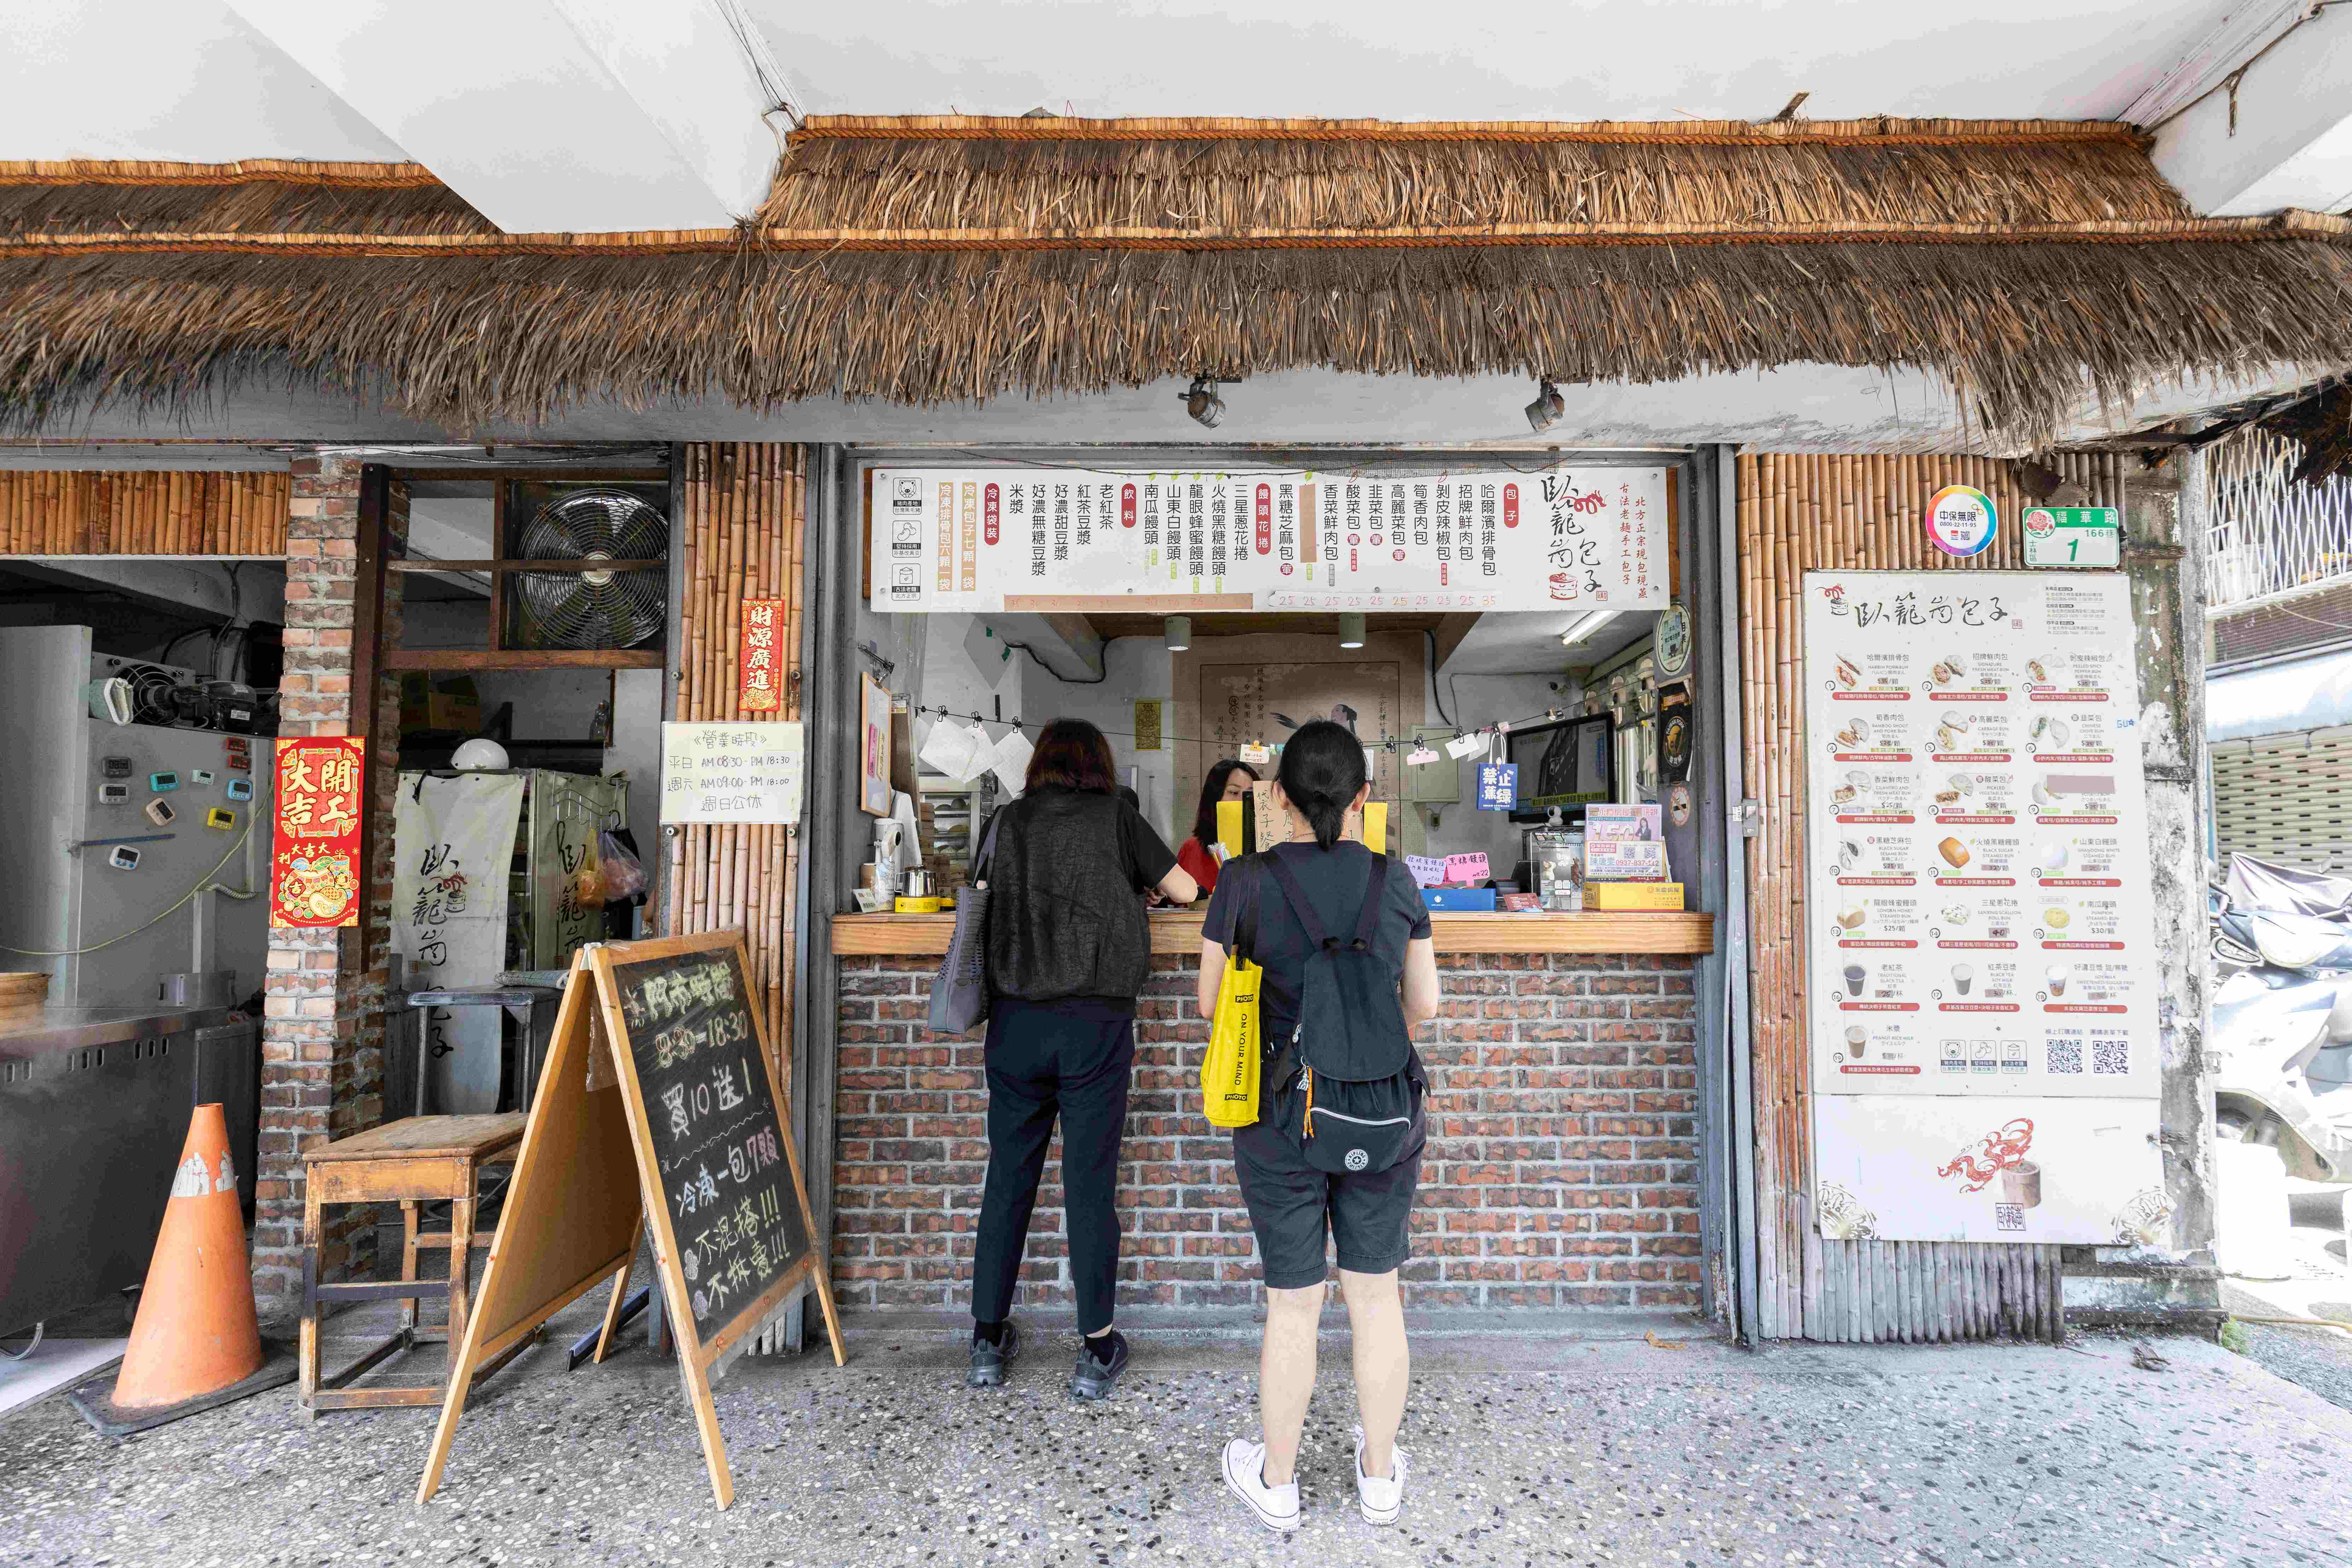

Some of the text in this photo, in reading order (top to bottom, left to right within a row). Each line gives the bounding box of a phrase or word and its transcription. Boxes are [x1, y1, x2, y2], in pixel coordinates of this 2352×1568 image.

[987, 488, 998, 538] 冷凍袋裝
[1010, 484, 1023, 513] 米漿
[1077, 484, 1090, 544] 紅茶豆漿
[1100, 484, 1113, 529] 老紅茶
[1124, 488, 1134, 521] 飲料
[1145, 484, 1158, 544] 南瓜饅頭
[1258, 488, 1269, 549] 饅頭花捲
[1347, 485, 1360, 529] 酸菜包
[1369, 485, 1382, 529] 韭菜包
[1392, 484, 1405, 544] 高麗菜包
[1414, 485, 1428, 544] 筍香肉包
[1505, 488, 1517, 521] 包子
[1939, 511, 1977, 521] 中保無限
[2056, 510, 2117, 524] 福華路
[939, 484, 951, 590] 冷凍排骨包六顆一袋
[963, 484, 975, 589] 冷凍包子七顆一袋
[1032, 484, 1046, 575] 好濃無糖豆漿
[1054, 484, 1068, 560] 好濃甜豆漿
[1167, 485, 1181, 560] 山東白饅頭
[1190, 484, 1203, 575] 龍眼蜂蜜饅頭
[1212, 484, 1225, 575] 火燒黑糖饅頭
[1280, 485, 1293, 560] 黑糖芝麻包
[1324, 485, 1338, 560] 香菜鮮肉包
[1437, 485, 1450, 560] 剝皮辣椒包
[1459, 485, 1473, 560] 招牌鮮肉包
[1482, 484, 1496, 575] 哈爾濱排骨包
[2085, 529, 2114, 538] 166巷
[1579, 538, 1601, 592] 包子
[1634, 496, 1648, 599] 北方正宗現包現蒸
[2029, 540, 2037, 562] 士林區
[2067, 538, 2079, 562] 1
[1279, 596, 1295, 605] 25
[1303, 596, 1316, 606] 25
[1325, 596, 1340, 606] 25
[1347, 596, 1361, 606] 25
[1370, 596, 1384, 606] 25
[1393, 596, 1408, 606] 25
[1416, 596, 1428, 606] 25
[1437, 596, 1451, 606] 25
[1459, 596, 1475, 606] 25
[1482, 596, 1496, 605] 35
[746, 605, 774, 690] 財源廣進
[667, 777, 693, 792] 週六
[701, 780, 716, 789] AM
[716, 776, 743, 788] 09:00
[751, 778, 763, 788] PM
[669, 755, 790, 769] 平日 AM 08:30 PM 18:30
[283, 759, 319, 826] 大吉
[320, 759, 353, 824] 開工
[701, 795, 762, 812] 週日公休
[1448, 854, 1487, 866] 黑糖饅頭
[1235, 1013, 1247, 1086] ON YOUR MIND
